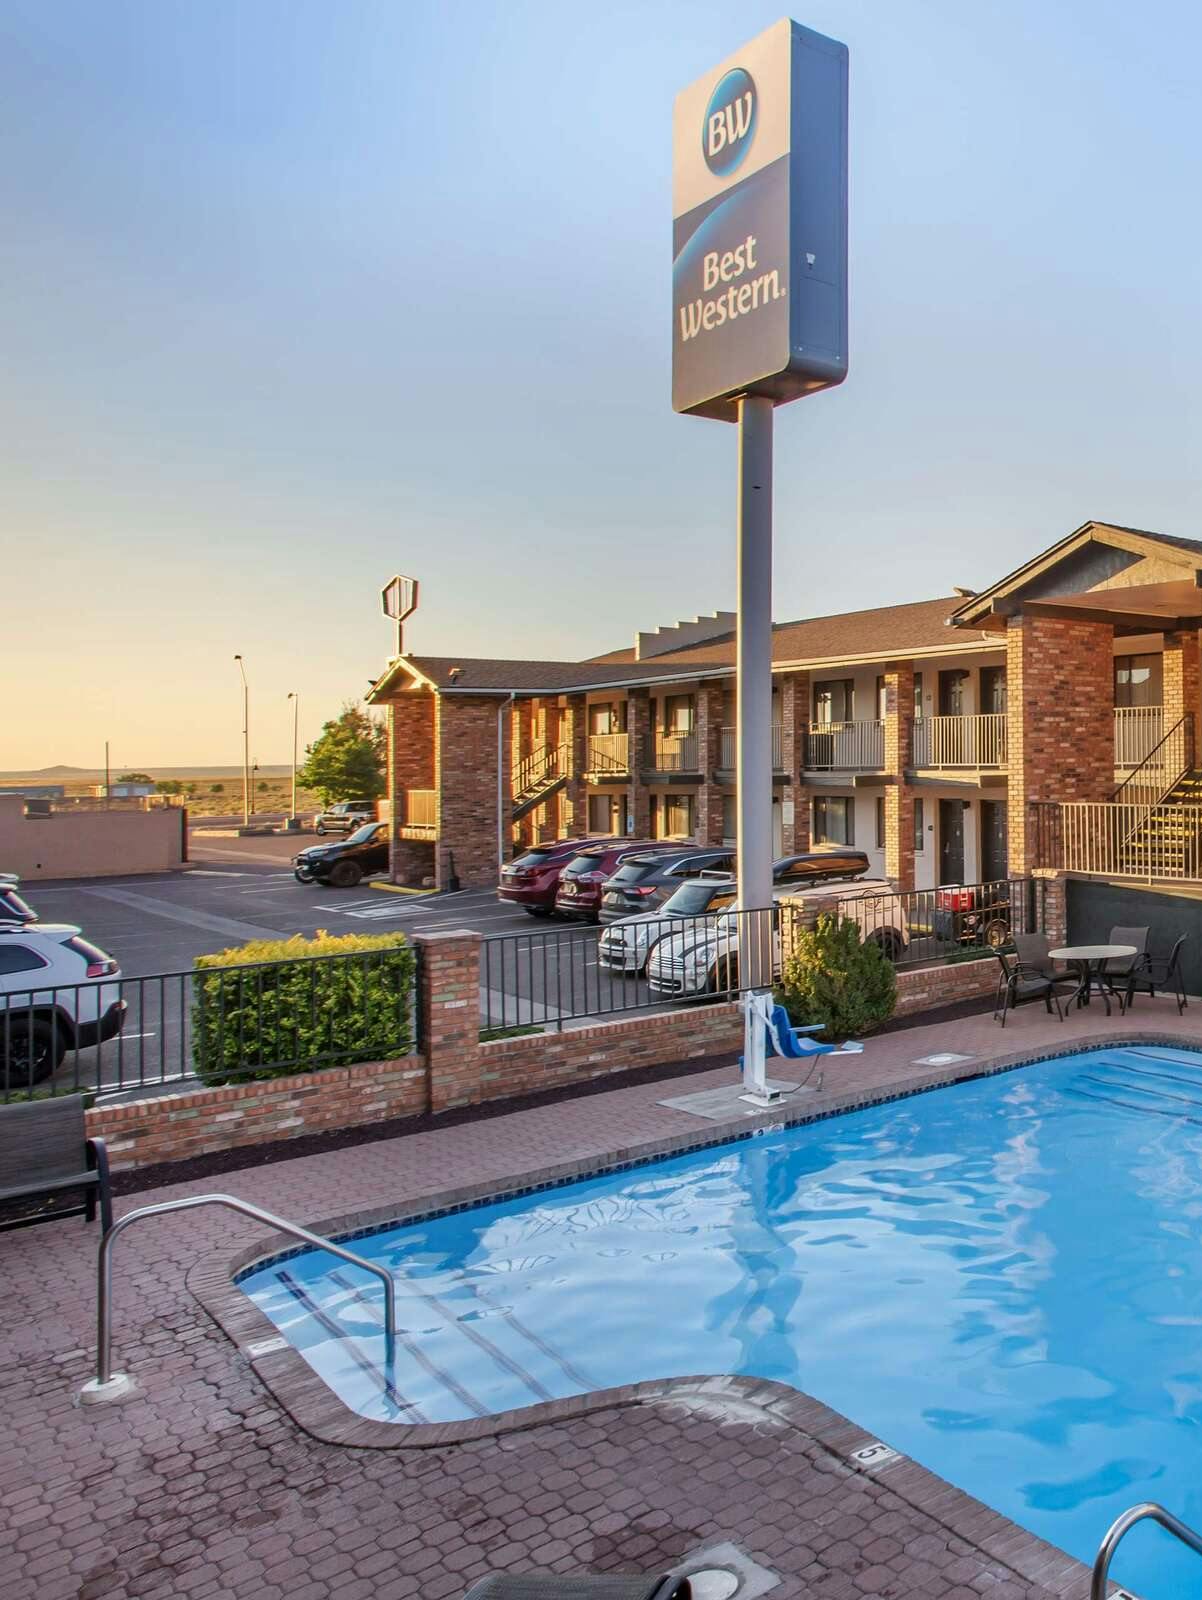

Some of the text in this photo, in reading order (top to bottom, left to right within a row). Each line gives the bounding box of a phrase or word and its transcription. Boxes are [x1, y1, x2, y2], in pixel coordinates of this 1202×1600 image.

[709, 91, 753, 157] BW
[703, 235, 757, 291] Best
[857, 1445, 887, 1459] 5
